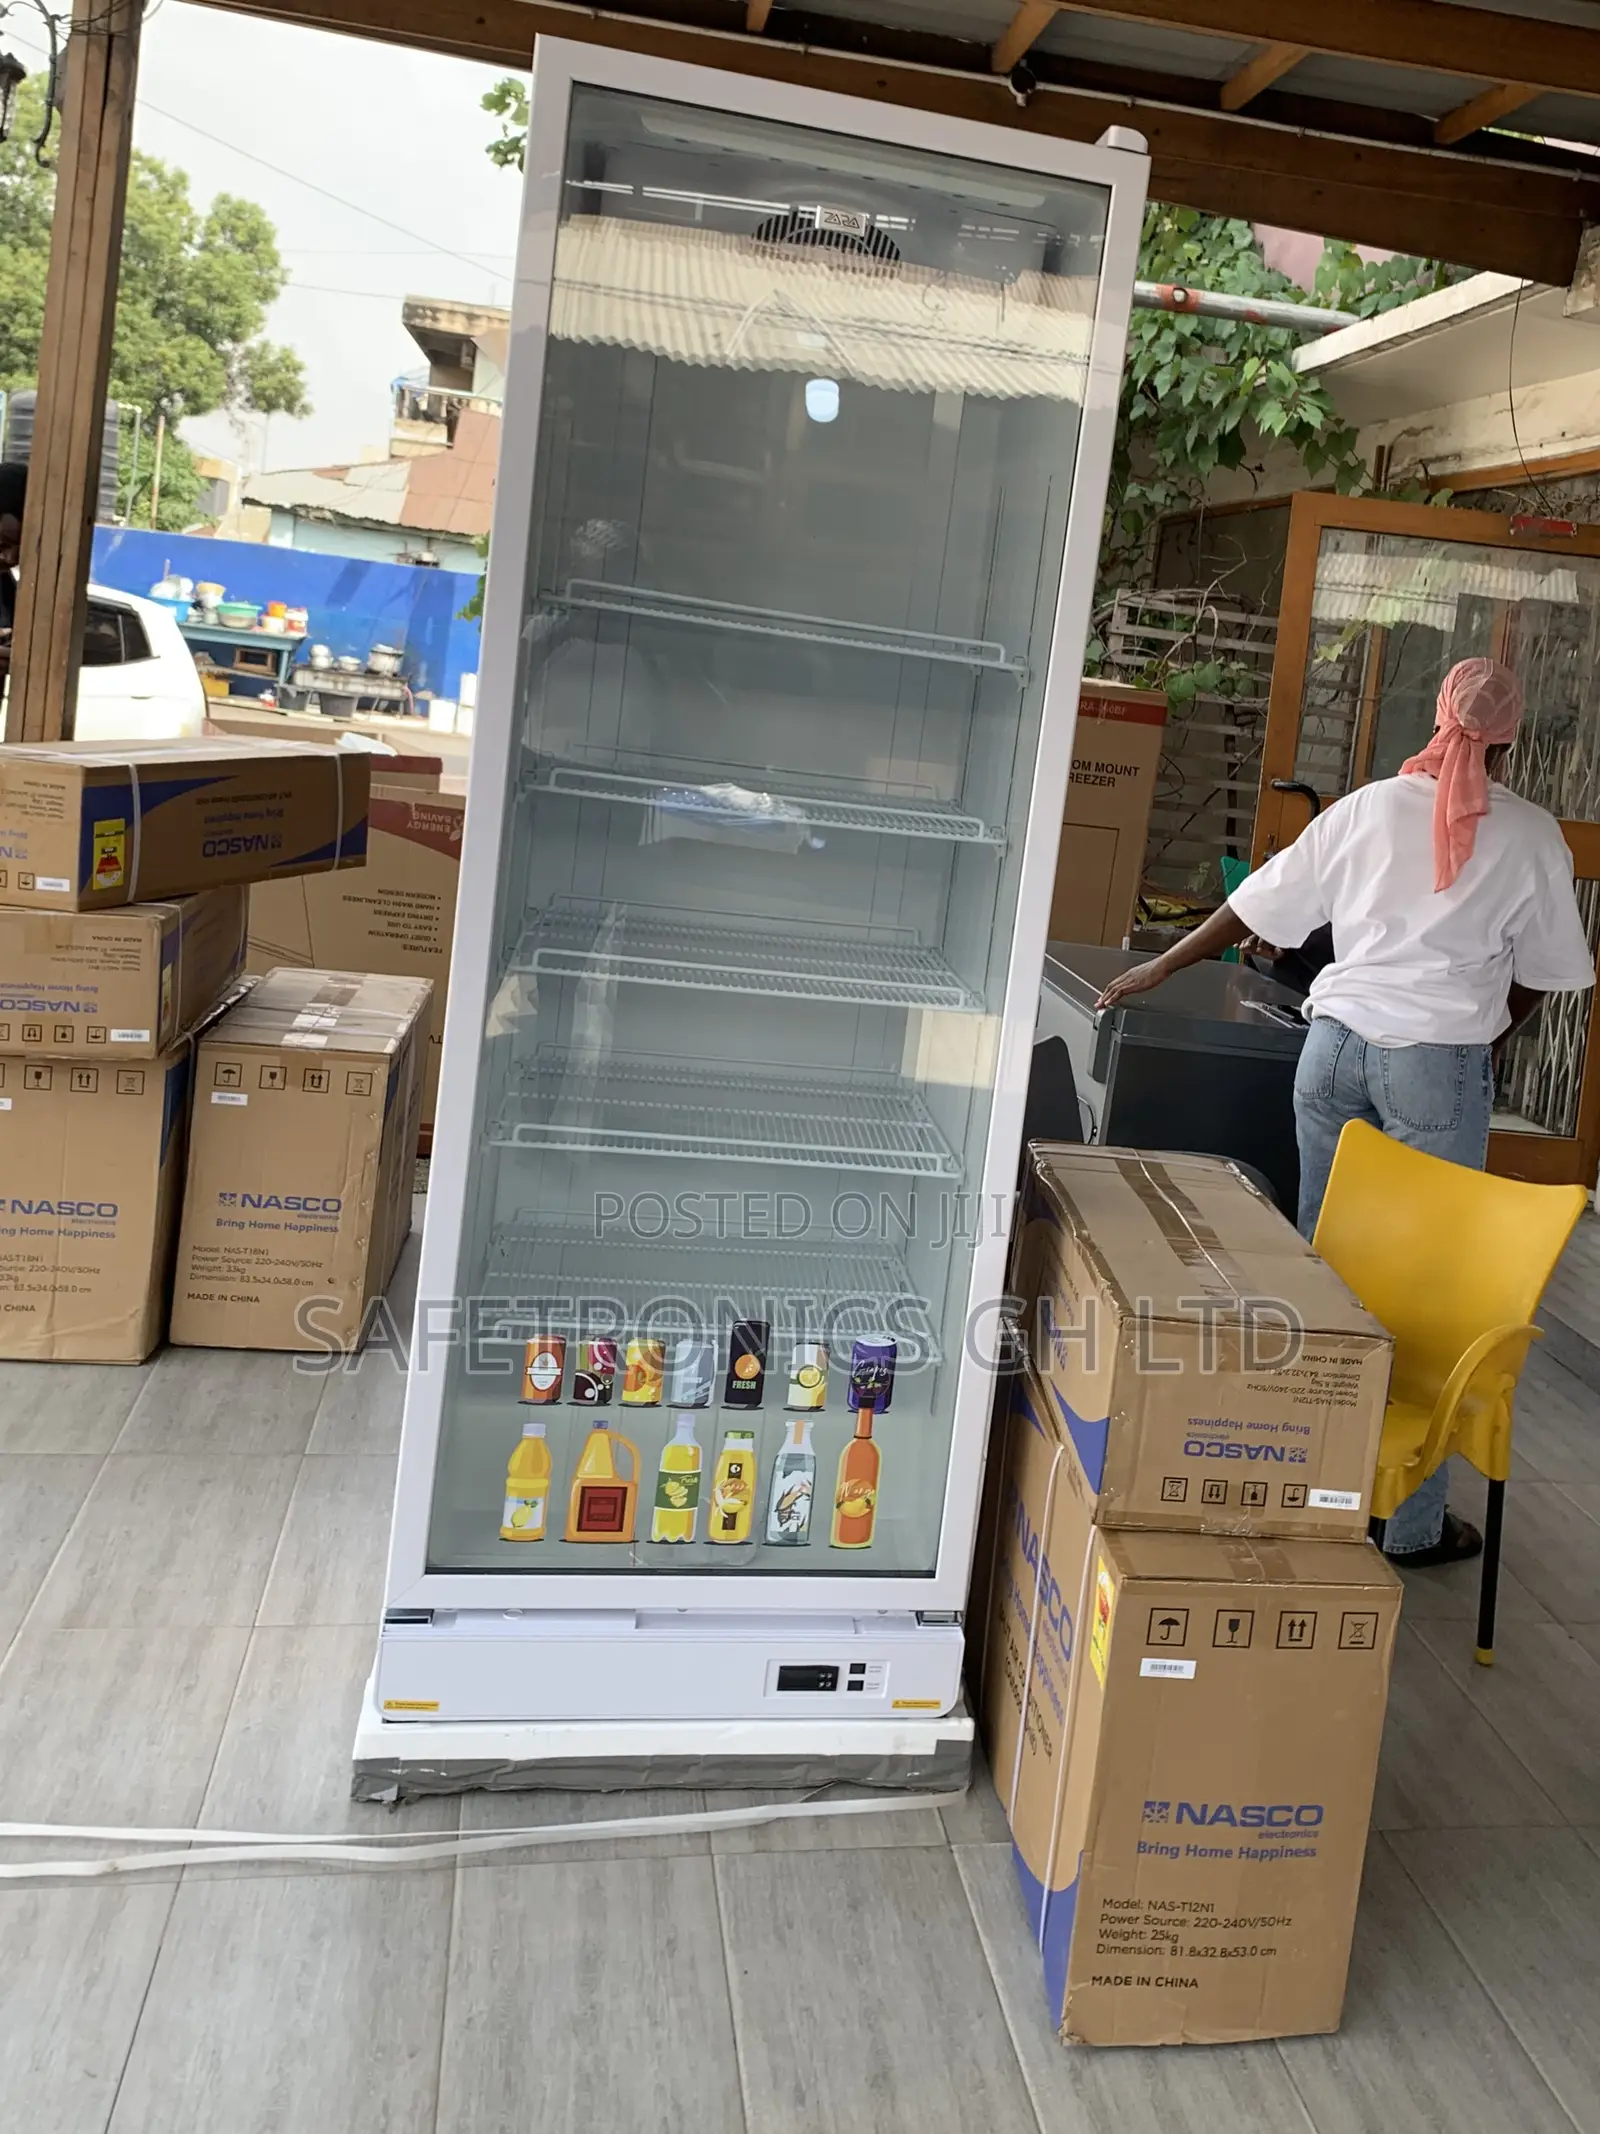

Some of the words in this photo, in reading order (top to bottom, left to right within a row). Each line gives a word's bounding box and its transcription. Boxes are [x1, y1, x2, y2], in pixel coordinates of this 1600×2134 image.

[1095, 762, 1140, 777] MOUNT
[407, 821, 451, 833] ENERGY
[202, 834, 269, 858] NASCO
[0, 999, 80, 1013] NASCO
[11, 1199, 118, 1218] NASCO
[241, 1193, 342, 1213] NASCO
[20, 1226, 54, 1237] Home
[58, 1227, 116, 1239] Happiness
[216, 1218, 245, 1230] Bring
[248, 1220, 280, 1230] Home
[284, 1222, 339, 1234] Happiness
[187, 1293, 215, 1301] MADE
[230, 1294, 260, 1303] CHINA
[3, 1304, 36, 1312] CHINA
[1301, 1355, 1327, 1363] CHINA
[1340, 1357, 1363, 1366] MADE
[732, 1380, 757, 1390] FRESH
[1187, 1417, 1243, 1431] Happiness
[1246, 1422, 1279, 1433] Home
[1282, 1422, 1311, 1436] Bring
[1183, 1440, 1285, 1462] NASCO
[1016, 1498, 1073, 1662] NASCO
[1175, 1801, 1324, 1828] NASCO
[1258, 1828, 1319, 1839] electronics
[1136, 1840, 1180, 1859] Bring
[1185, 1843, 1233, 1858] Home
[1238, 1844, 1317, 1863] Happiness
[1102, 1898, 1143, 1910] Model:
[1147, 1900, 1215, 1913] NAS-T12N1
[1100, 1913, 1140, 1925] Power
[1143, 1914, 1190, 1928] Source:
[1193, 1916, 1292, 1929] 220-240V/50Hz
[1098, 1929, 1147, 1942] Weight:
[1150, 1929, 1180, 1943] 25kg
[1096, 1943, 1166, 1956] Dimension:
[1260, 1947, 1277, 1956] cm
[1091, 1975, 1133, 1987] MADE
[1136, 1976, 1151, 1987] IN
[1155, 1976, 1199, 1989] CHINA
